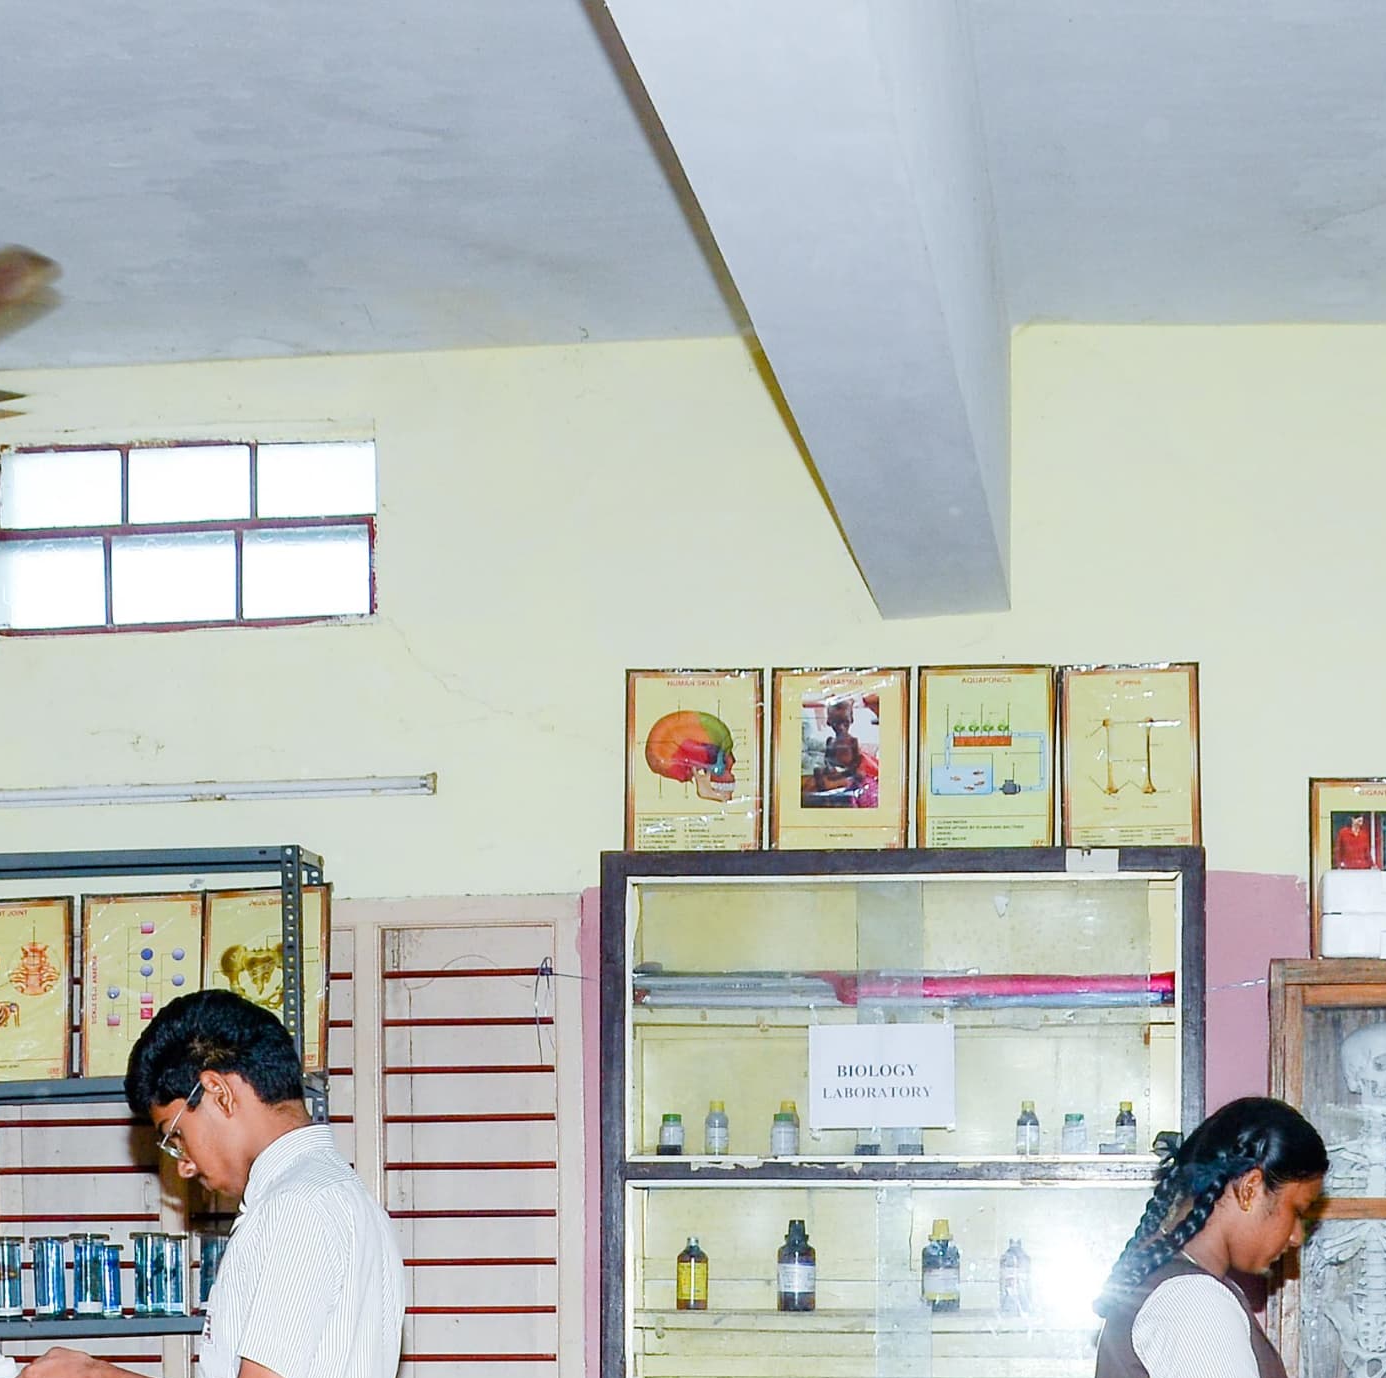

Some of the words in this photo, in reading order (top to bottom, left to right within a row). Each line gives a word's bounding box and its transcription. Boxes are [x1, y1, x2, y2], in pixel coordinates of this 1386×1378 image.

[961, 676, 1012, 684] AQUAPONICS
[7, 909, 28, 917] JOINT
[837, 1064, 917, 1078] BIOLOGY
[823, 1086, 932, 1099] LABORATORY
